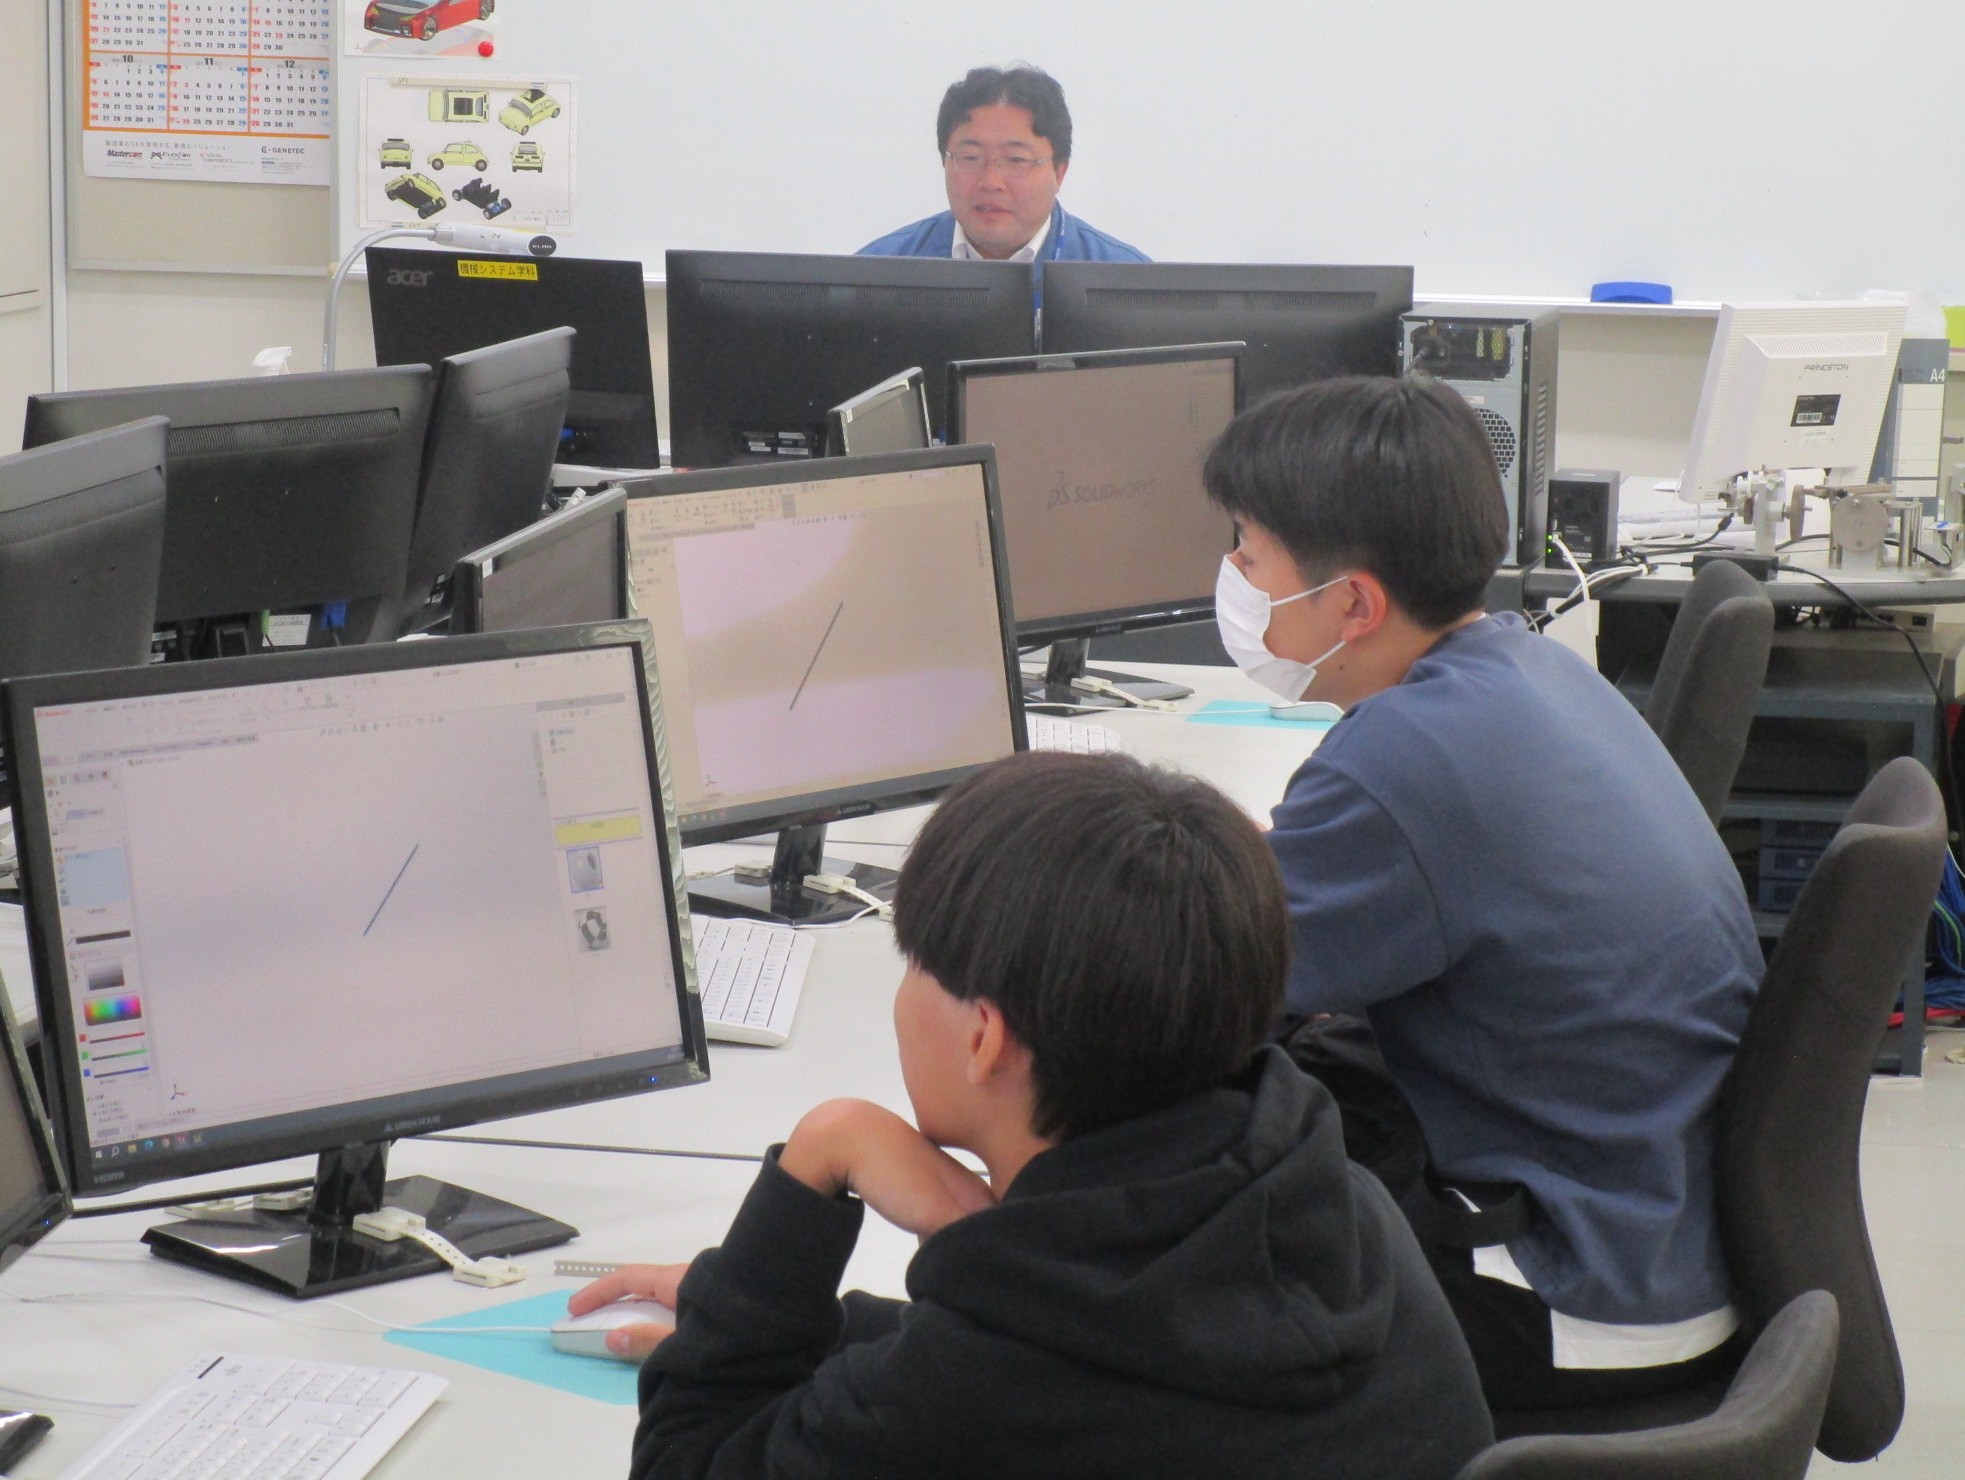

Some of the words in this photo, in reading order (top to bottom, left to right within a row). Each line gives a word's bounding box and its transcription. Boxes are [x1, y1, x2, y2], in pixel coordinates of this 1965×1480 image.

[122, 54, 134, 63] 10
[204, 58, 214, 66] 11
[284, 60, 295, 68] 12
[106, 149, 143, 159] Mastercam
[459, 262, 536, 278] 機械システム学科
[386, 267, 433, 287] acer
[1803, 361, 1849, 372] PRINCETON
[1929, 368, 1946, 383] A4
[1074, 479, 1158, 503] SOLIDWORKS
